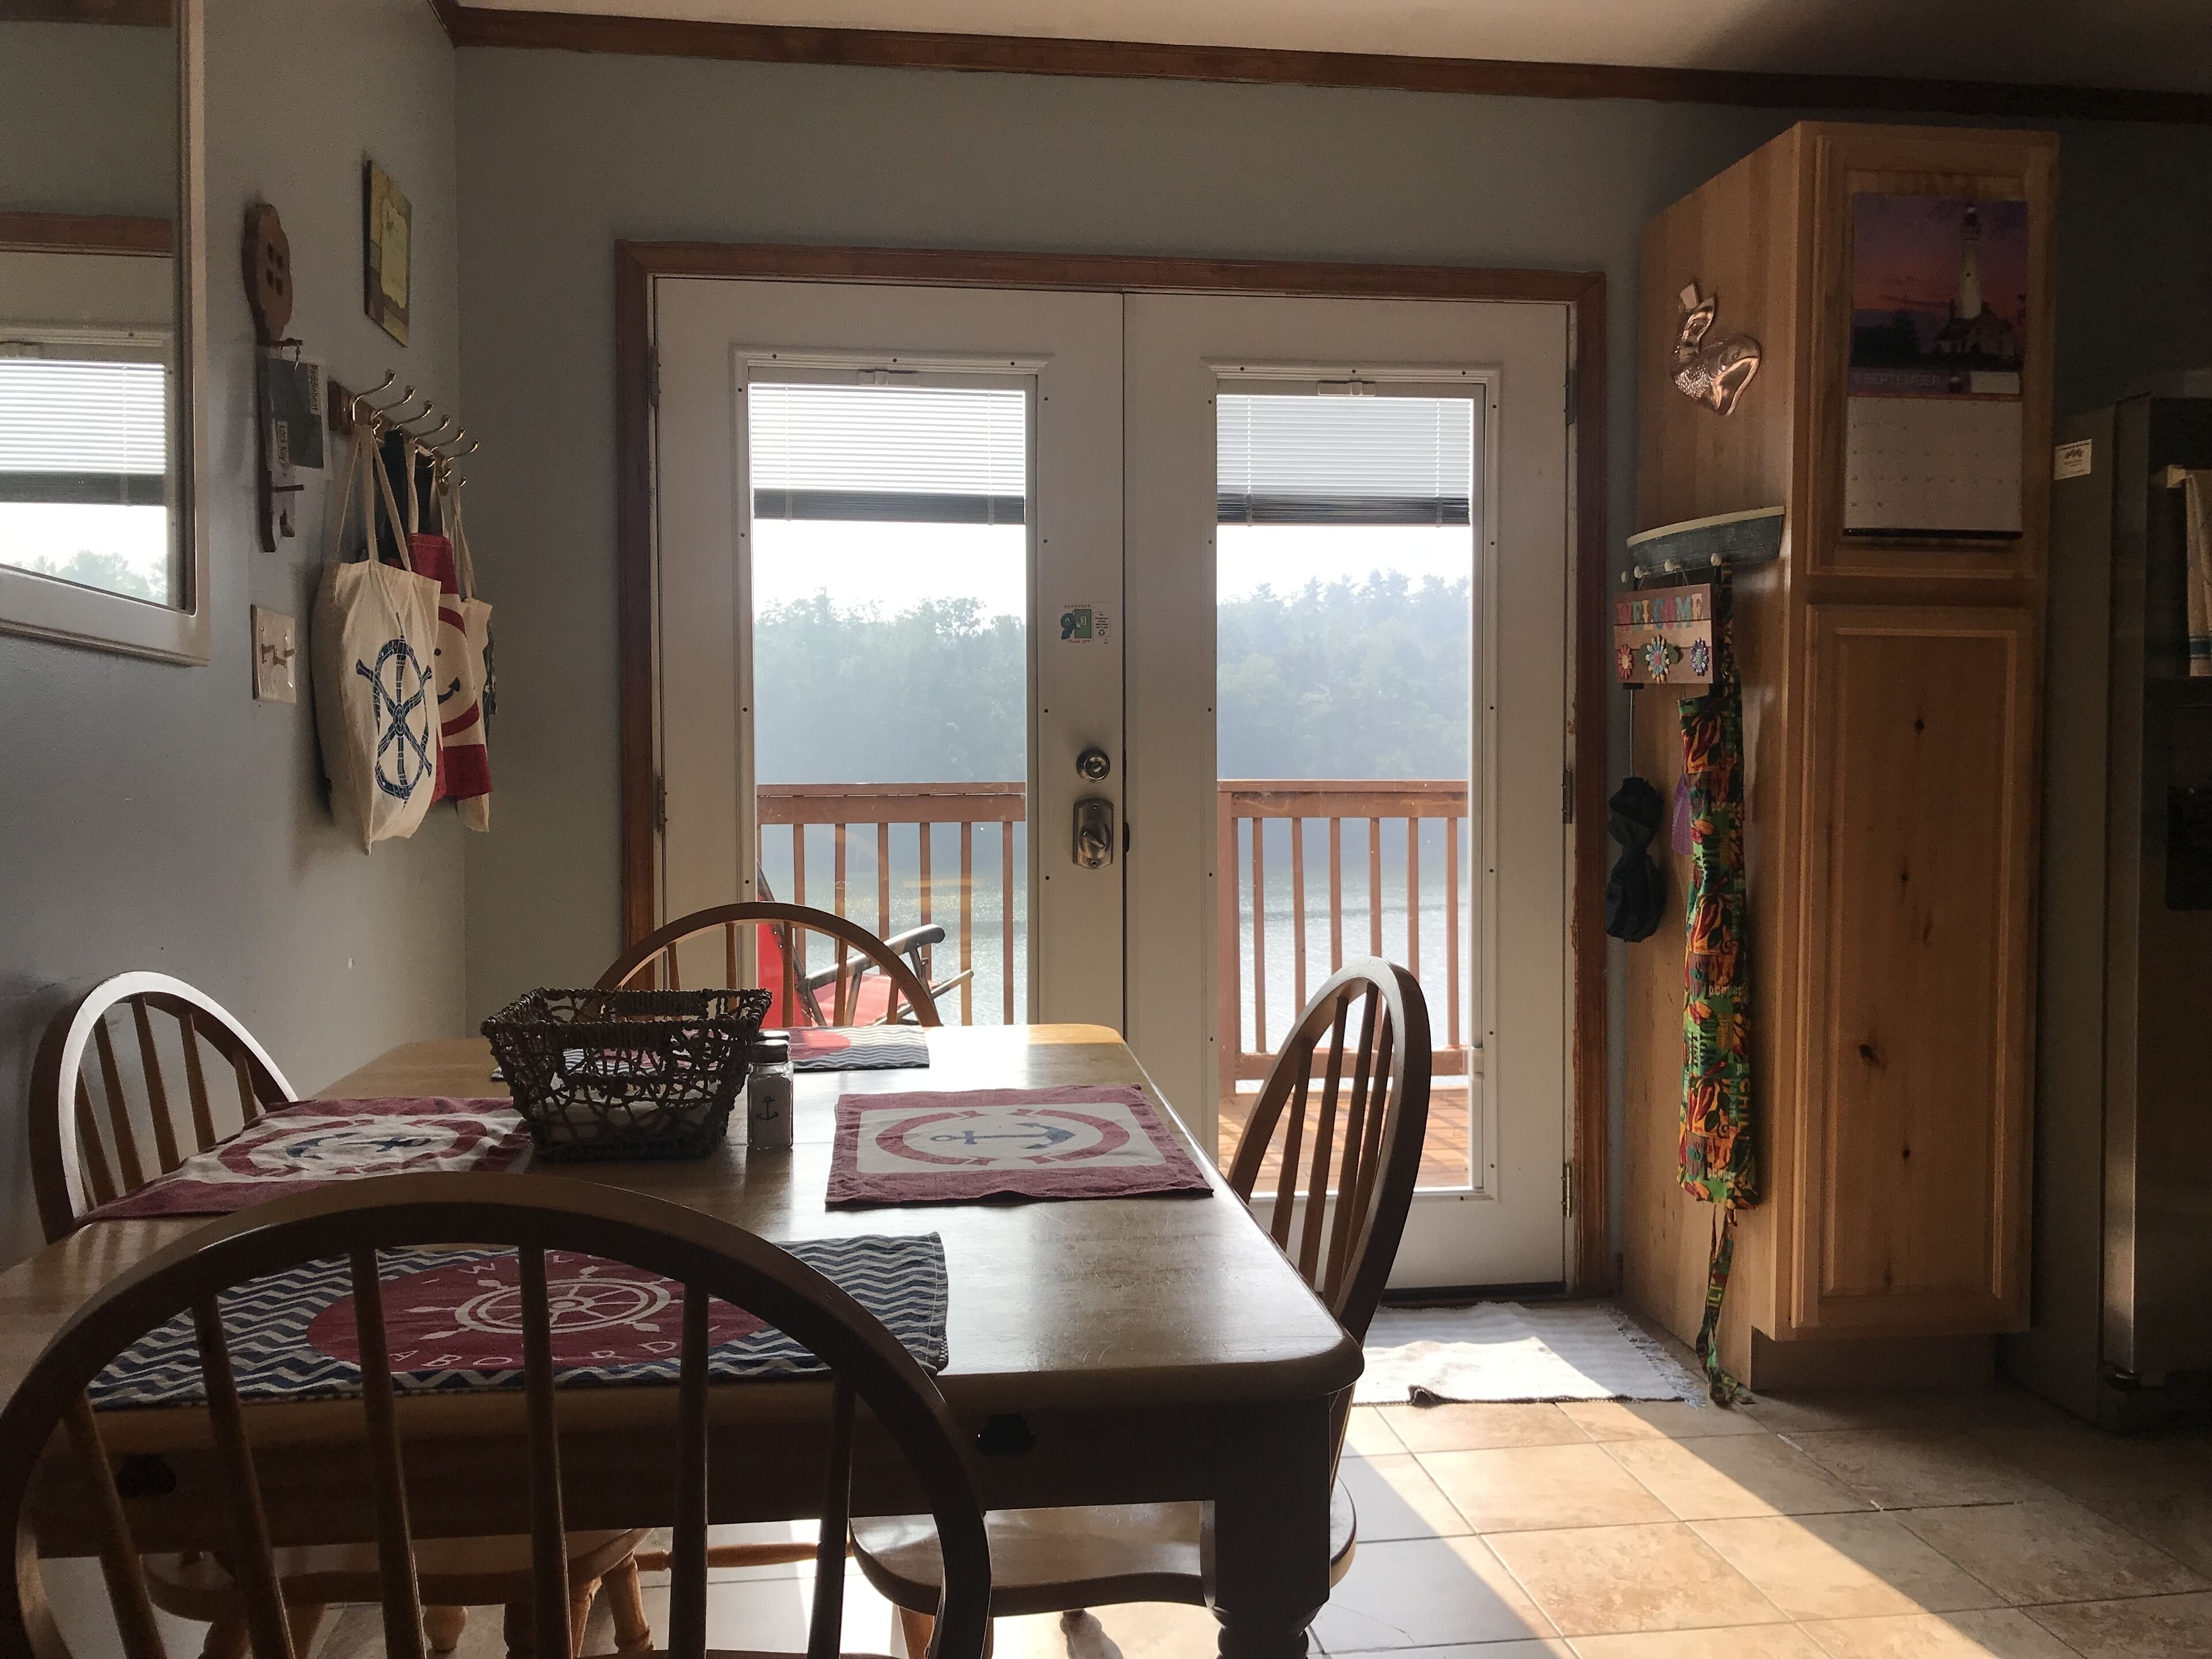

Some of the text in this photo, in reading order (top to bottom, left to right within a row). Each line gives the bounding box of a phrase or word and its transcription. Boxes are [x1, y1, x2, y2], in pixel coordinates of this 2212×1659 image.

[1862, 373, 1941, 387] SEPTEMBER
[1616, 593, 1704, 631] WELCOME
[389, 1340, 678, 1367] ABORD
